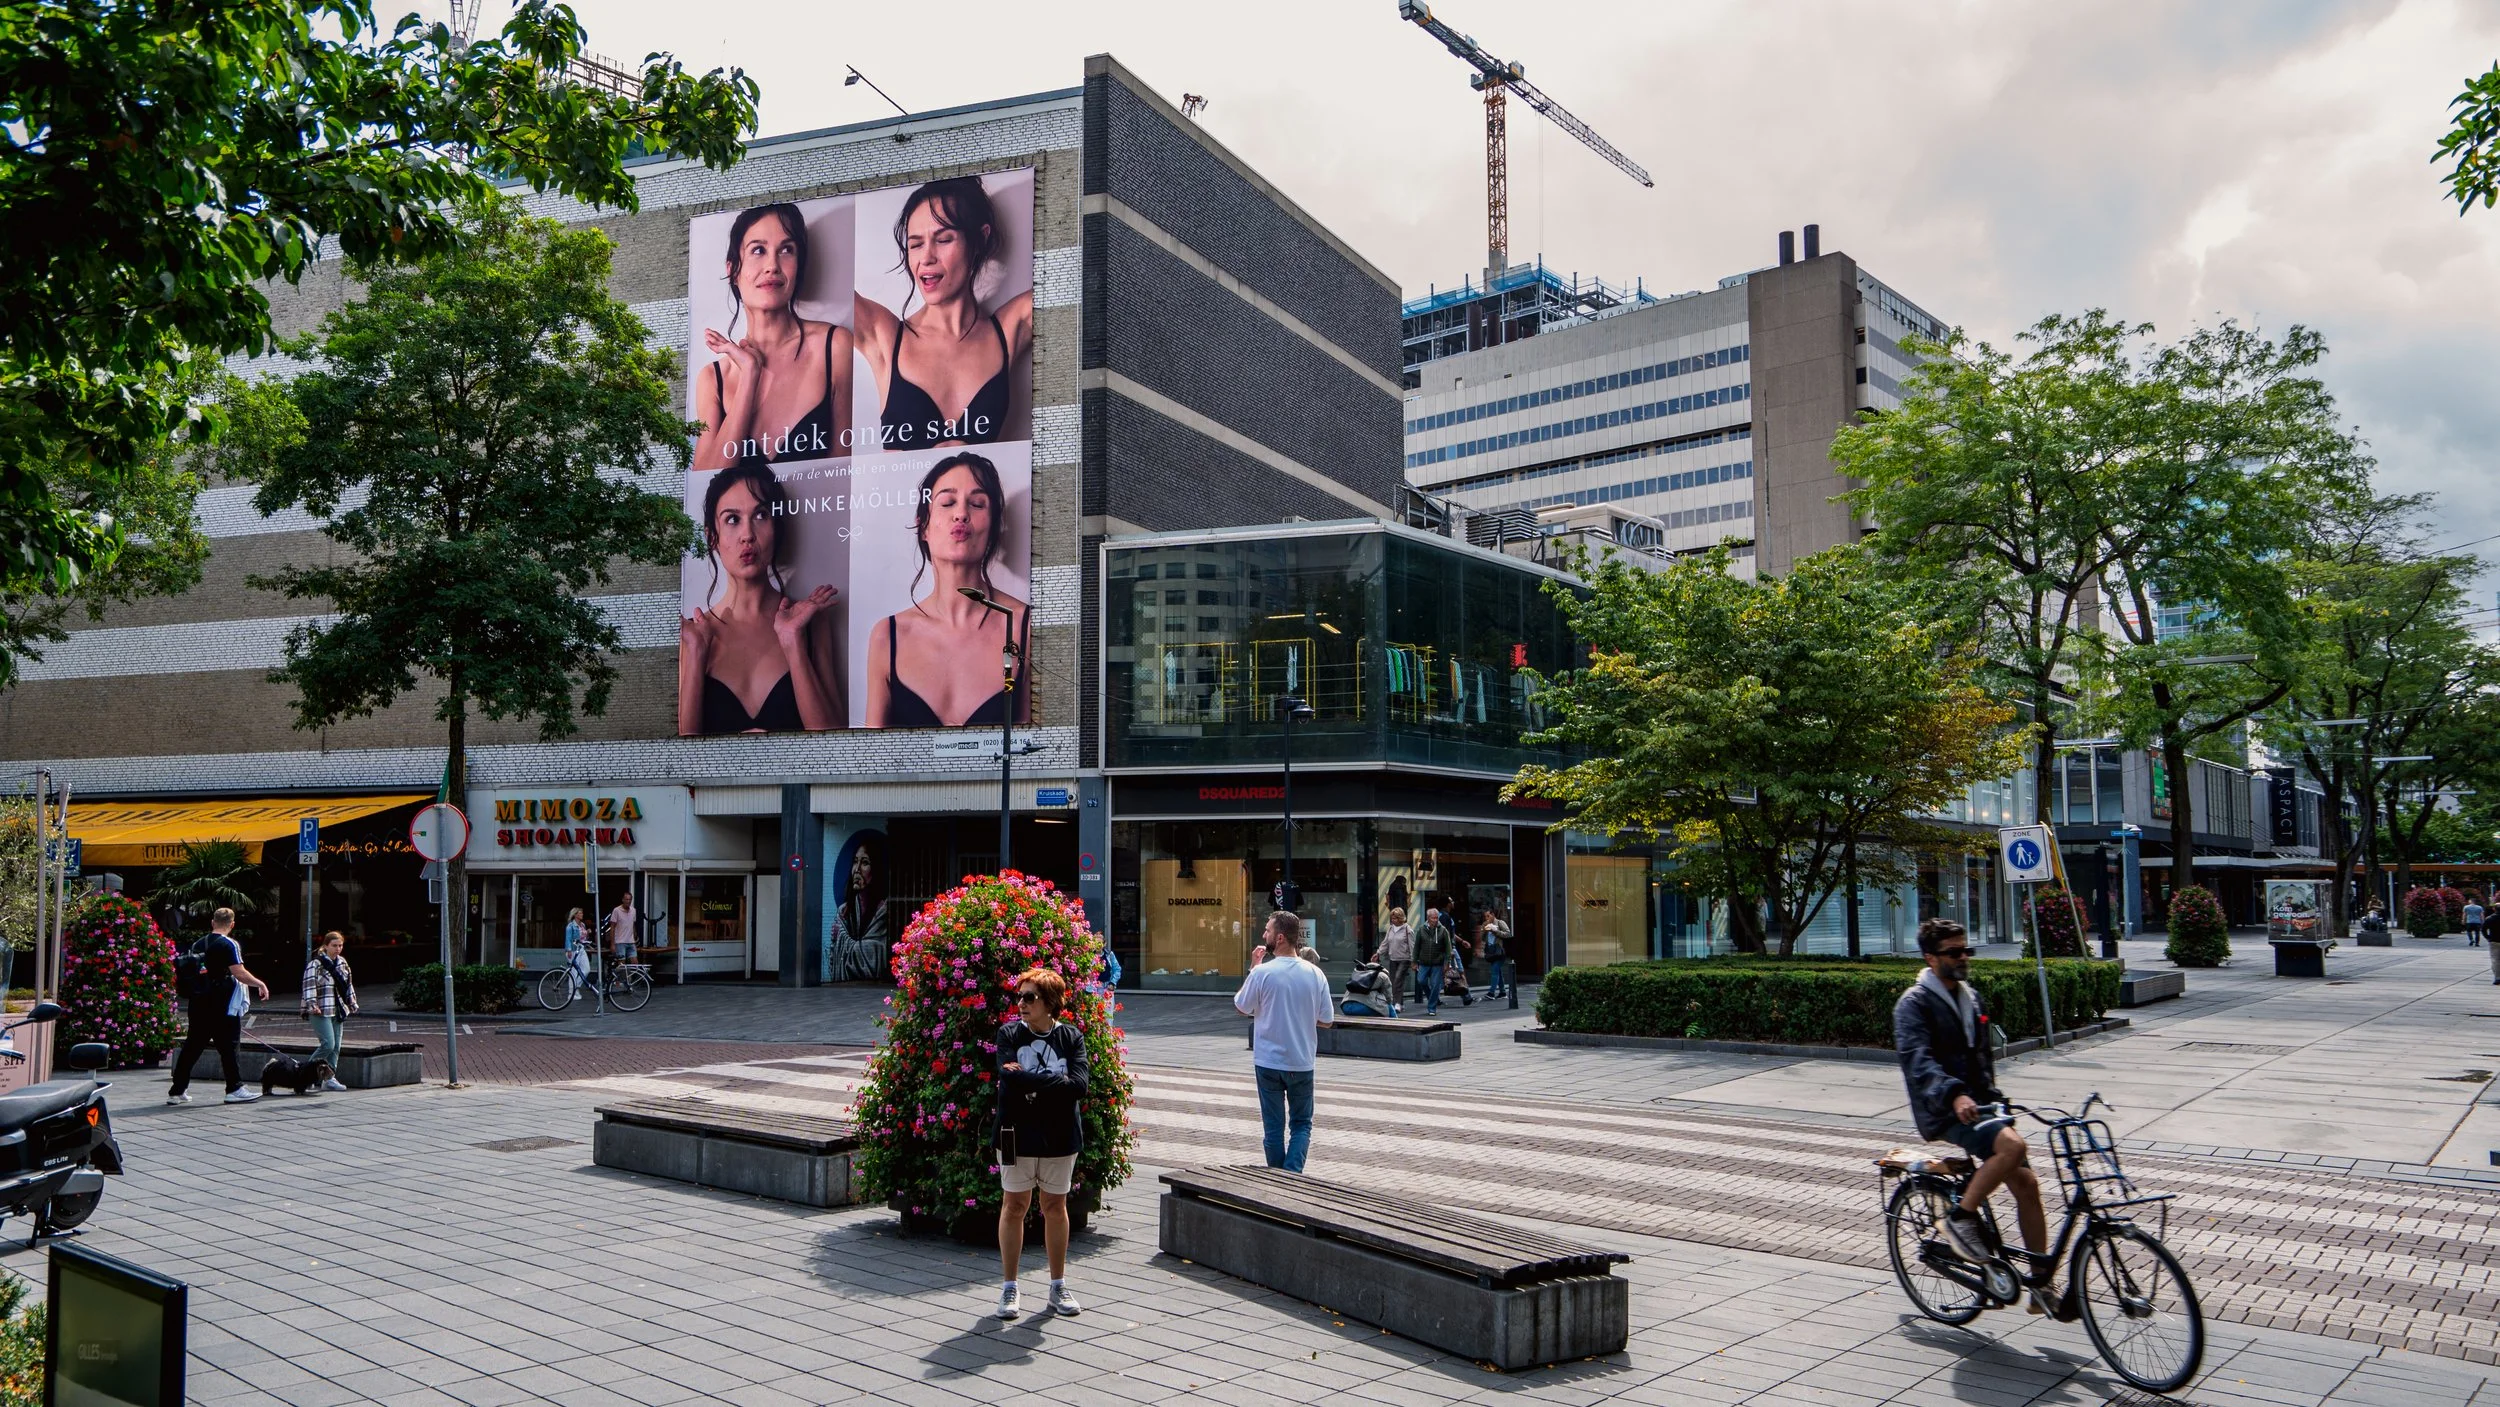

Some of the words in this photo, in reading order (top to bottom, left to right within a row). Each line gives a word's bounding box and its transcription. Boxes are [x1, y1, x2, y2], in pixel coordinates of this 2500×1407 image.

[722, 423, 828, 460] ontdek
[839, 421, 914, 448] onze
[925, 407, 990, 440] sale
[774, 472, 788, 483] nu
[792, 470, 803, 481] in
[807, 467, 821, 480] de
[824, 464, 866, 478] winkel
[871, 464, 886, 473] en
[891, 460, 931, 472] online
[771, 487, 933, 517] HUNKEMÖLLER
[1199, 786, 1285, 800] DSQUARED2
[495, 796, 643, 822] MIMOZA
[2279, 778, 2293, 837] ASPACT
[303, 821, 314, 838] P
[497, 827, 636, 847] SHOARMA
[303, 854, 313, 863] 2x
[701, 900, 733, 911] Mimoza
[1168, 898, 1223, 906] DSQUARED2
